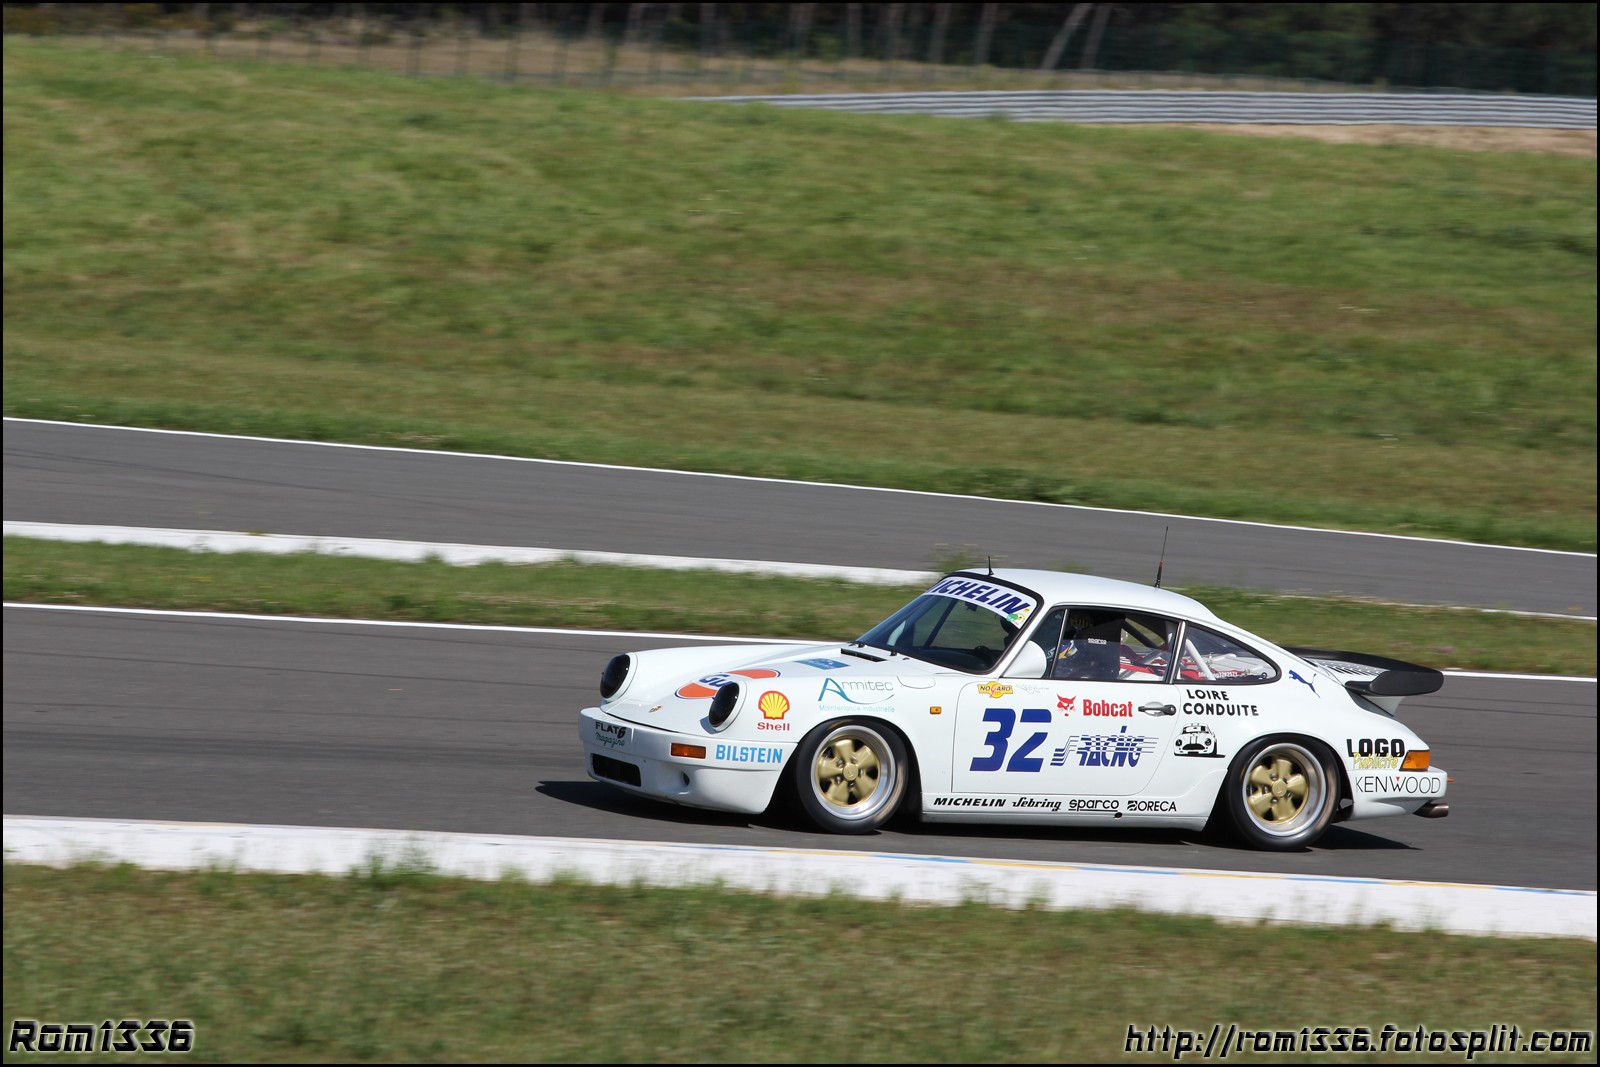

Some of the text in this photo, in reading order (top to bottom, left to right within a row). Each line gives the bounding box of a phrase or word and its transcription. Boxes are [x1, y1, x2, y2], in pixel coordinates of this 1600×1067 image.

[818, 677, 894, 704] Armitec
[979, 684, 1011, 697] NOGARO
[1186, 689, 1230, 701] LOIRE
[1083, 699, 1133, 717] Bobcat
[1183, 702, 1259, 717] CONDUITE
[757, 722, 790, 731] Shell
[969, 708, 1052, 772] 32
[716, 744, 783, 764] BILSTEIN
[1346, 738, 1406, 758] LOGO
[1355, 776, 1441, 794] KENWOOD
[933, 797, 1006, 807] MICHELIN
[1012, 796, 1062, 812] Sebring
[1068, 799, 1120, 812] sparco
[1137, 801, 1177, 812] ORECA
